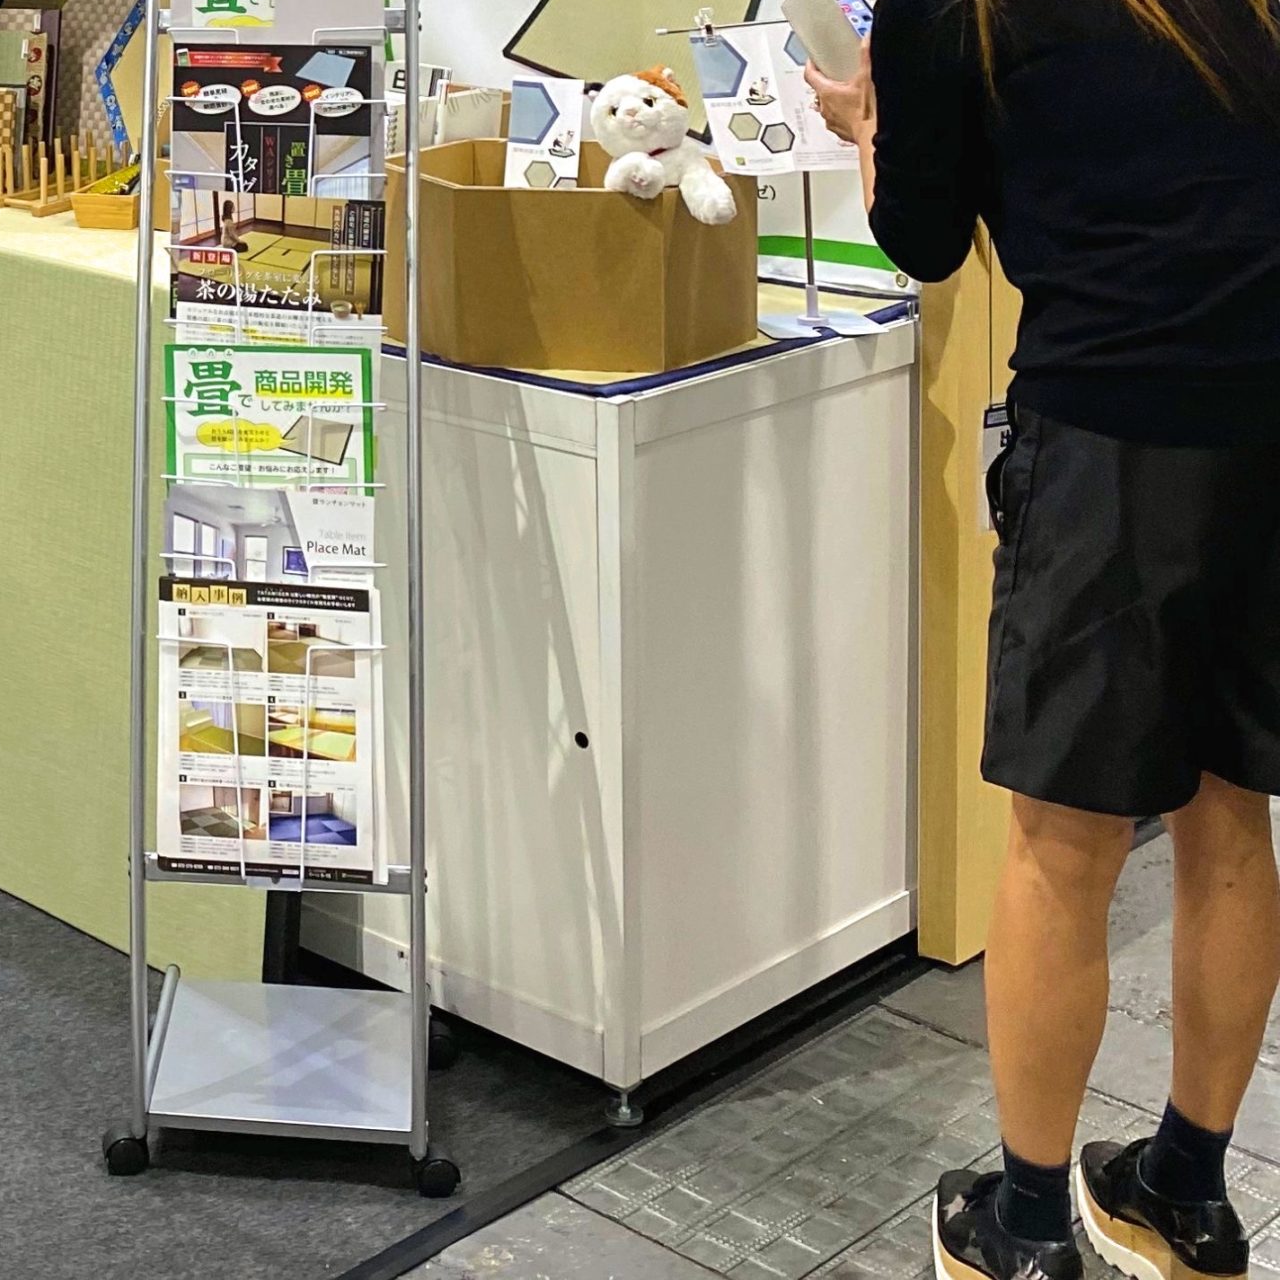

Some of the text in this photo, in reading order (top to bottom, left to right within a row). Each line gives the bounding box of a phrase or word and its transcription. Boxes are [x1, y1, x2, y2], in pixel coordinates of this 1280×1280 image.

[195, 278, 322, 307] 茶の湯たたみ
[183, 360, 242, 417] 畳
[254, 370, 354, 395] 商品開発
[306, 540, 367, 557] Place Mat
